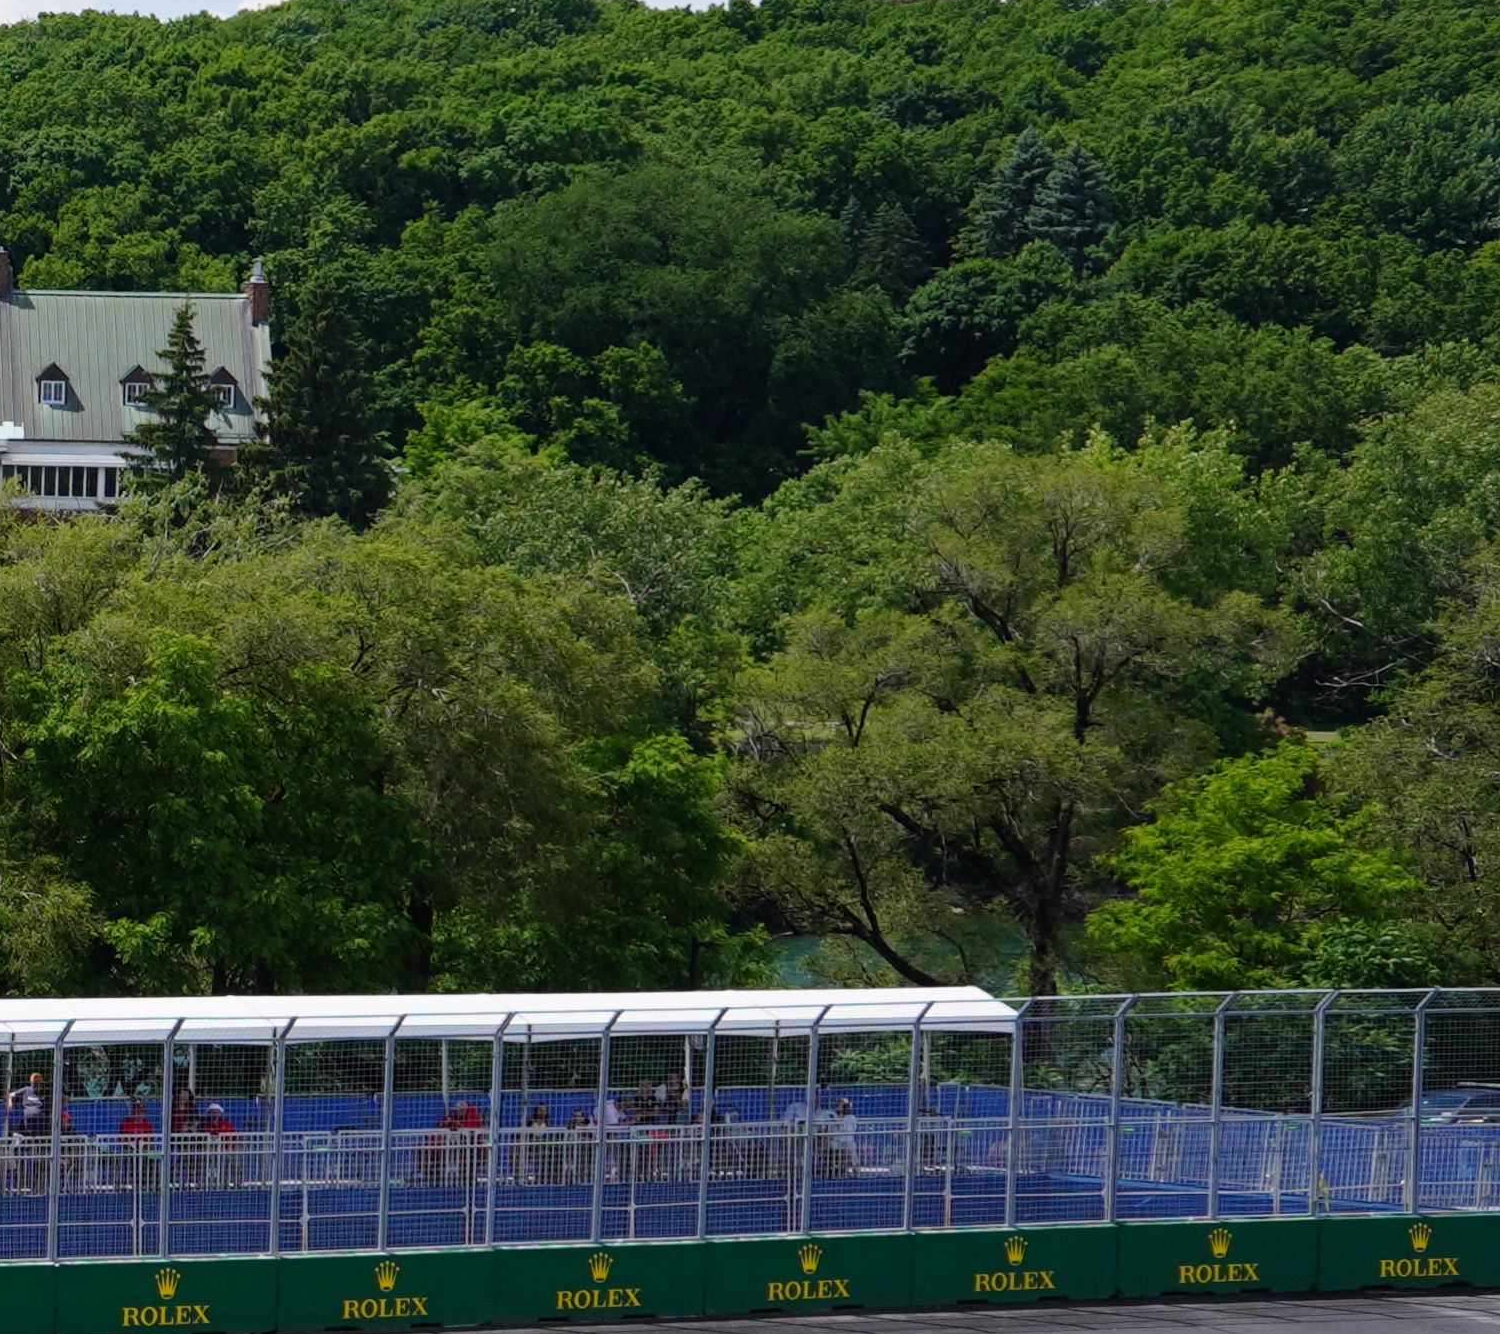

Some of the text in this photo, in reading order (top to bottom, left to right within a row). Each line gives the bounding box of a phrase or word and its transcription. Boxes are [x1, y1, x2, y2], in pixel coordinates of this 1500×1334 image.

[1178, 1262, 1259, 1284] ROLEX
[1379, 1257, 1460, 1278] ROLEX
[767, 1278, 850, 1301] ROLEX
[973, 1270, 1055, 1292] ROLEX
[342, 1297, 429, 1319] ROLEX
[555, 1287, 641, 1310] ROLEX
[121, 1304, 210, 1327] ROLEX
